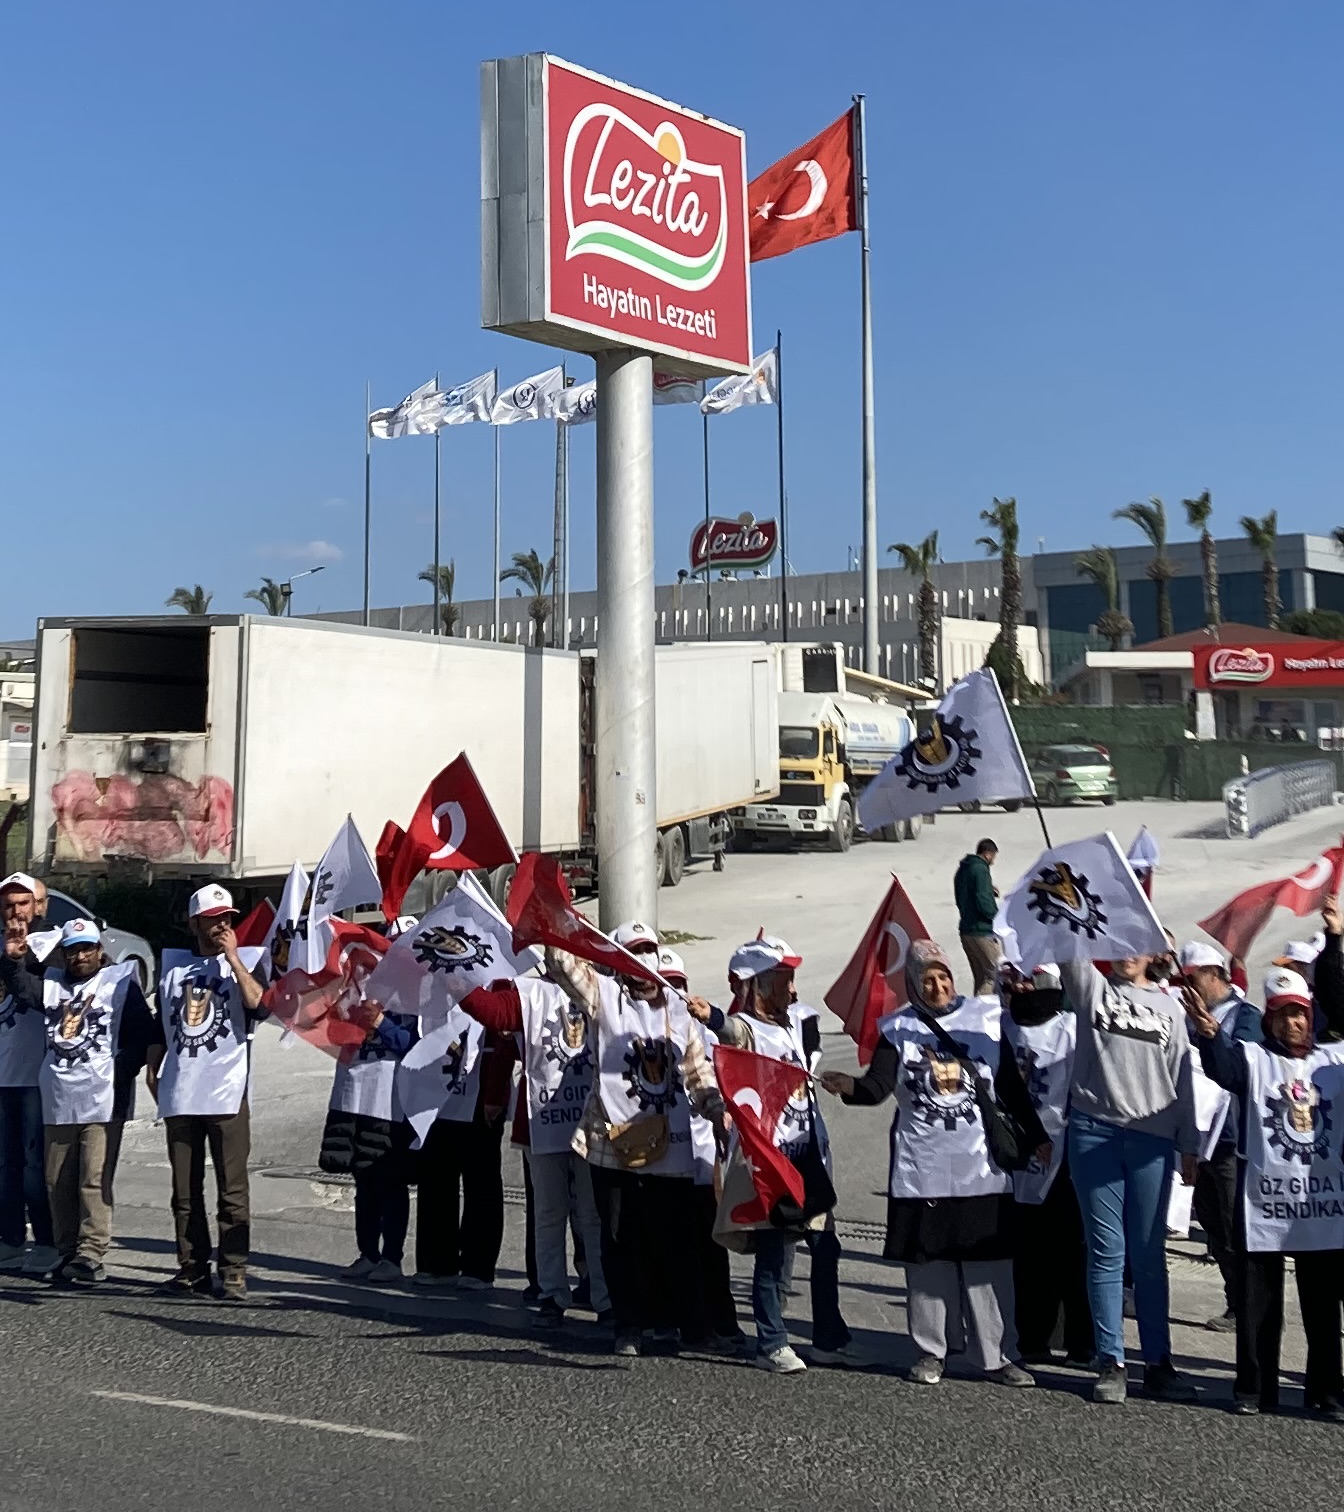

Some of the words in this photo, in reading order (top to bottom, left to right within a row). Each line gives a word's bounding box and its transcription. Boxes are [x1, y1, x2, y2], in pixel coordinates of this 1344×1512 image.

[584, 117, 709, 238] Lezita
[583, 273, 652, 321] Hayatın
[656, 294, 717, 339] Lezzeti
[697, 521, 769, 559] Lezita
[1260, 1174, 1284, 1196] ÖZ
[1289, 1176, 1334, 1195] GIDA
